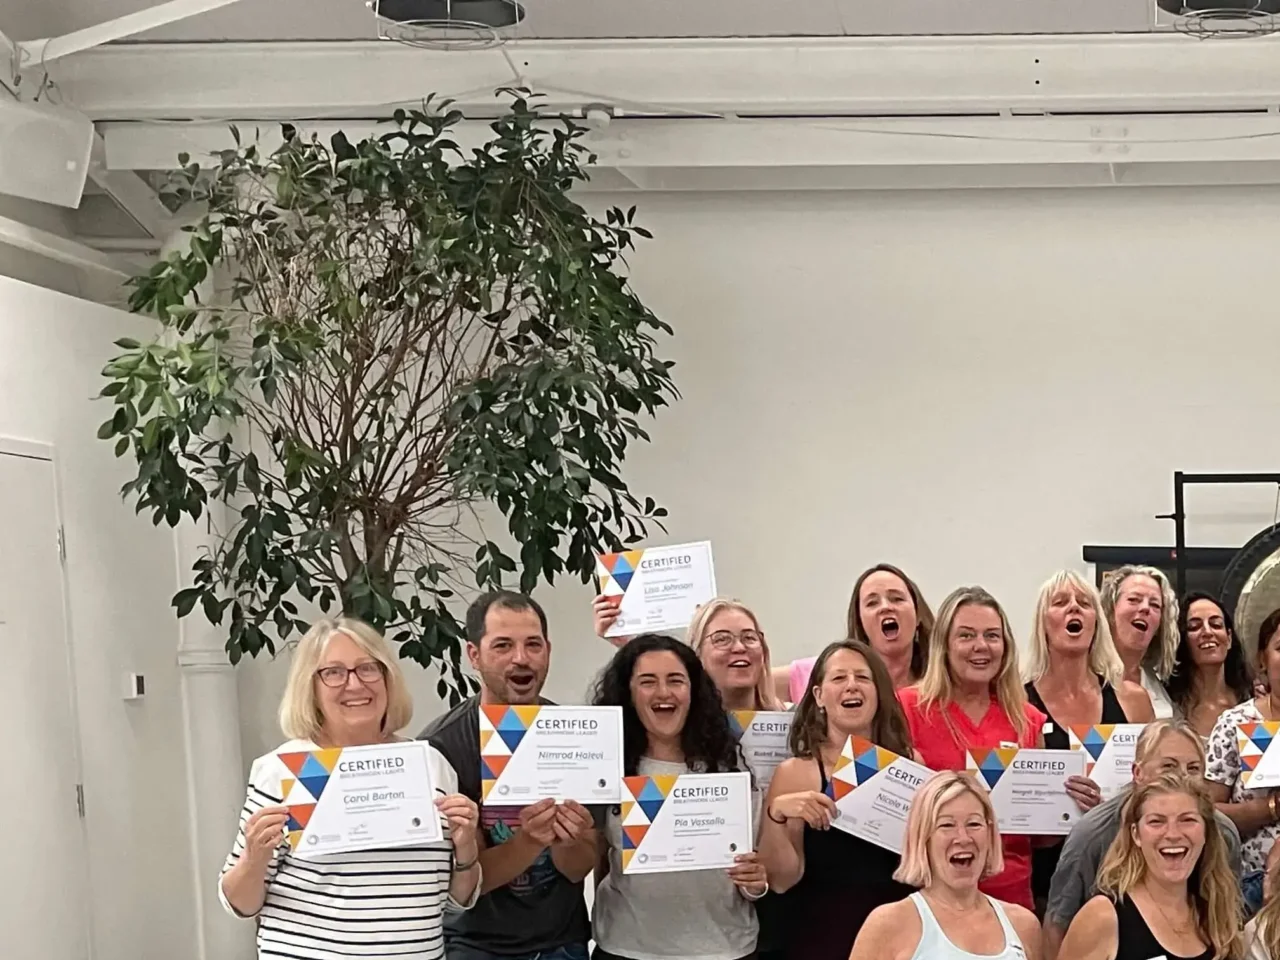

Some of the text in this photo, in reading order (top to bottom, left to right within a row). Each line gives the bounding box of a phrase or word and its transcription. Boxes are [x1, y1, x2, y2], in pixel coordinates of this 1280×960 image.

[641, 555, 691, 569] CERTIFIED
[536, 719, 598, 730] CERTIFIED
[752, 722, 788, 732] CERTIF
[538, 751, 574, 760] Nimrod
[338, 757, 404, 773] CERTIFIED
[1012, 760, 1066, 770] CERTIFIED
[887, 766, 924, 786] CERTIF
[343, 790, 405, 805] Carol Barton
[673, 786, 728, 798] CERTIFIED
[674, 819, 688, 827] Pia
